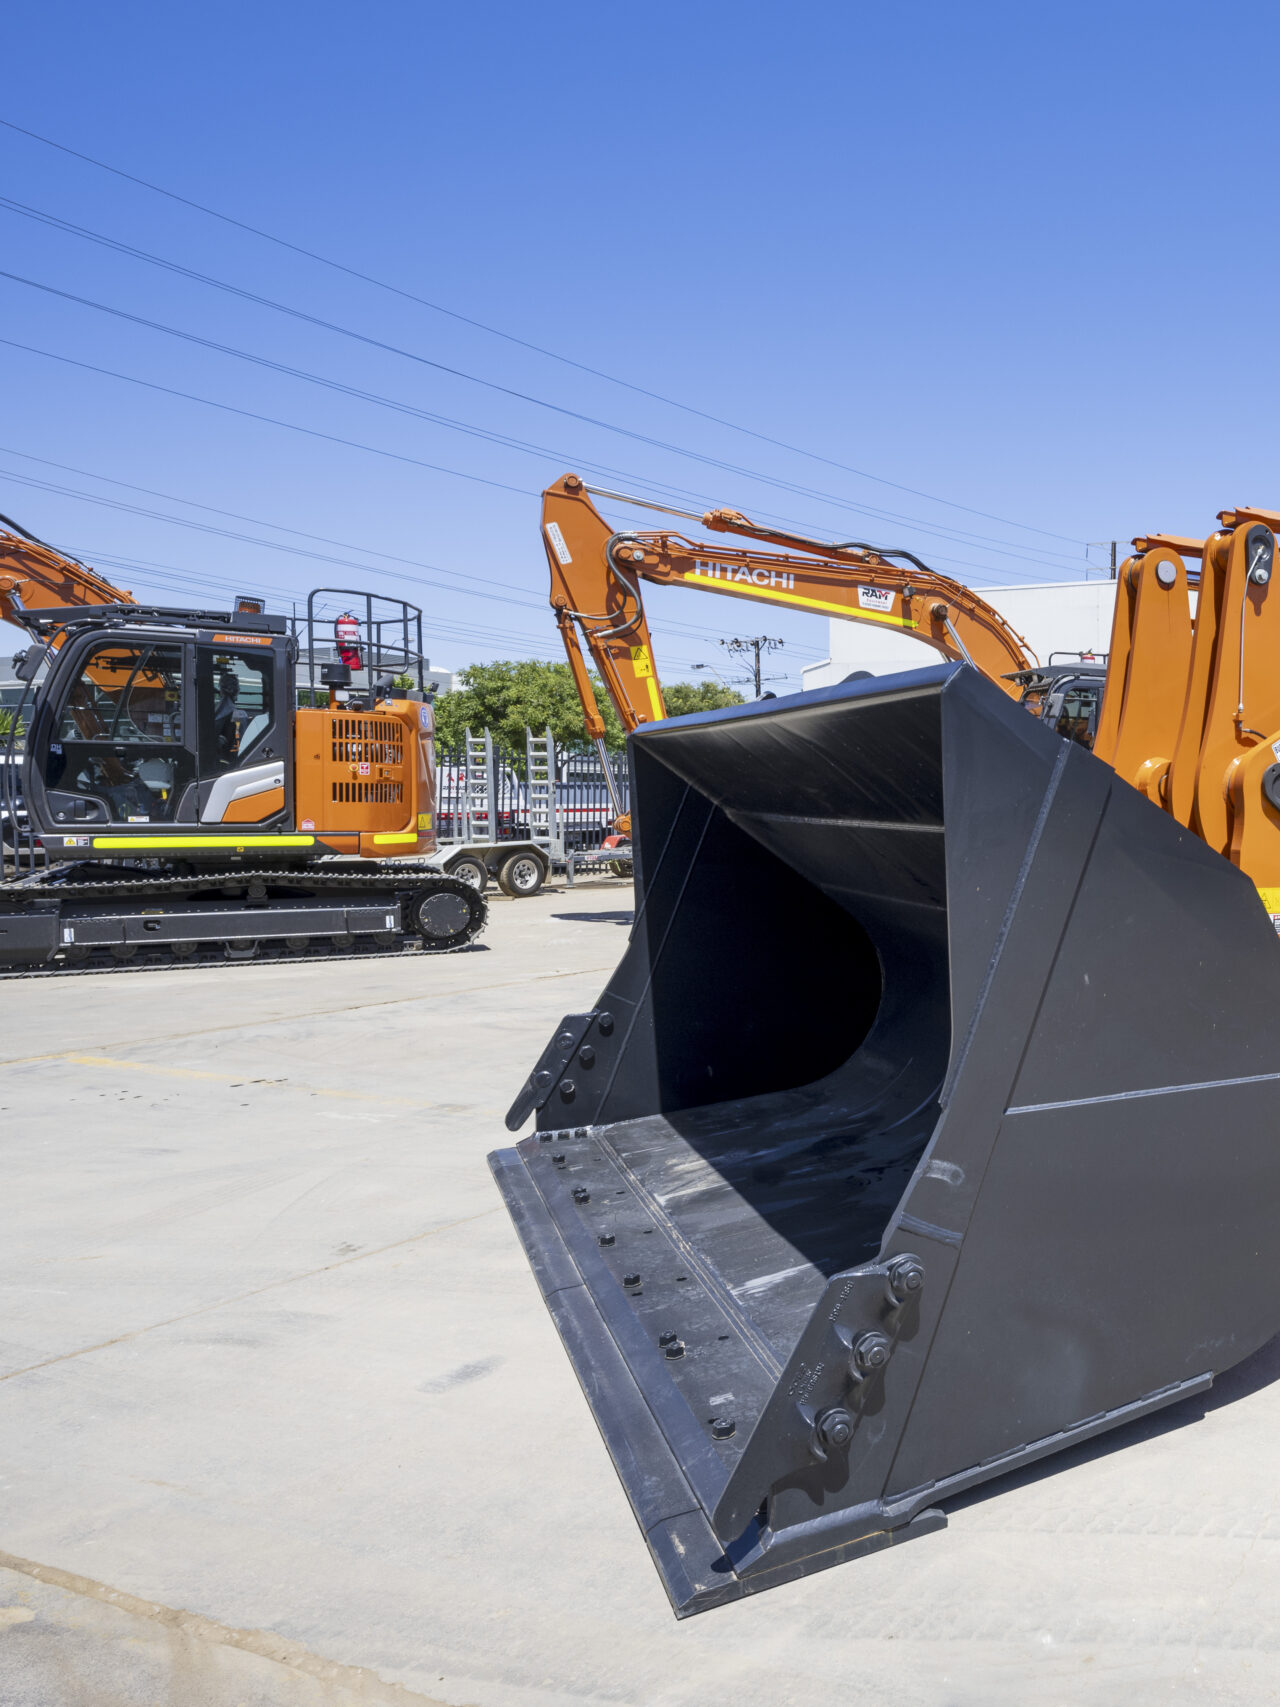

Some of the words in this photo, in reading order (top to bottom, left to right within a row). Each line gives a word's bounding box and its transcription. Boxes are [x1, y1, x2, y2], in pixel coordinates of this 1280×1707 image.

[695, 560, 795, 589] HITACHI
[862, 588, 890, 600] RAM
[225, 635, 260, 643] HITACHI
